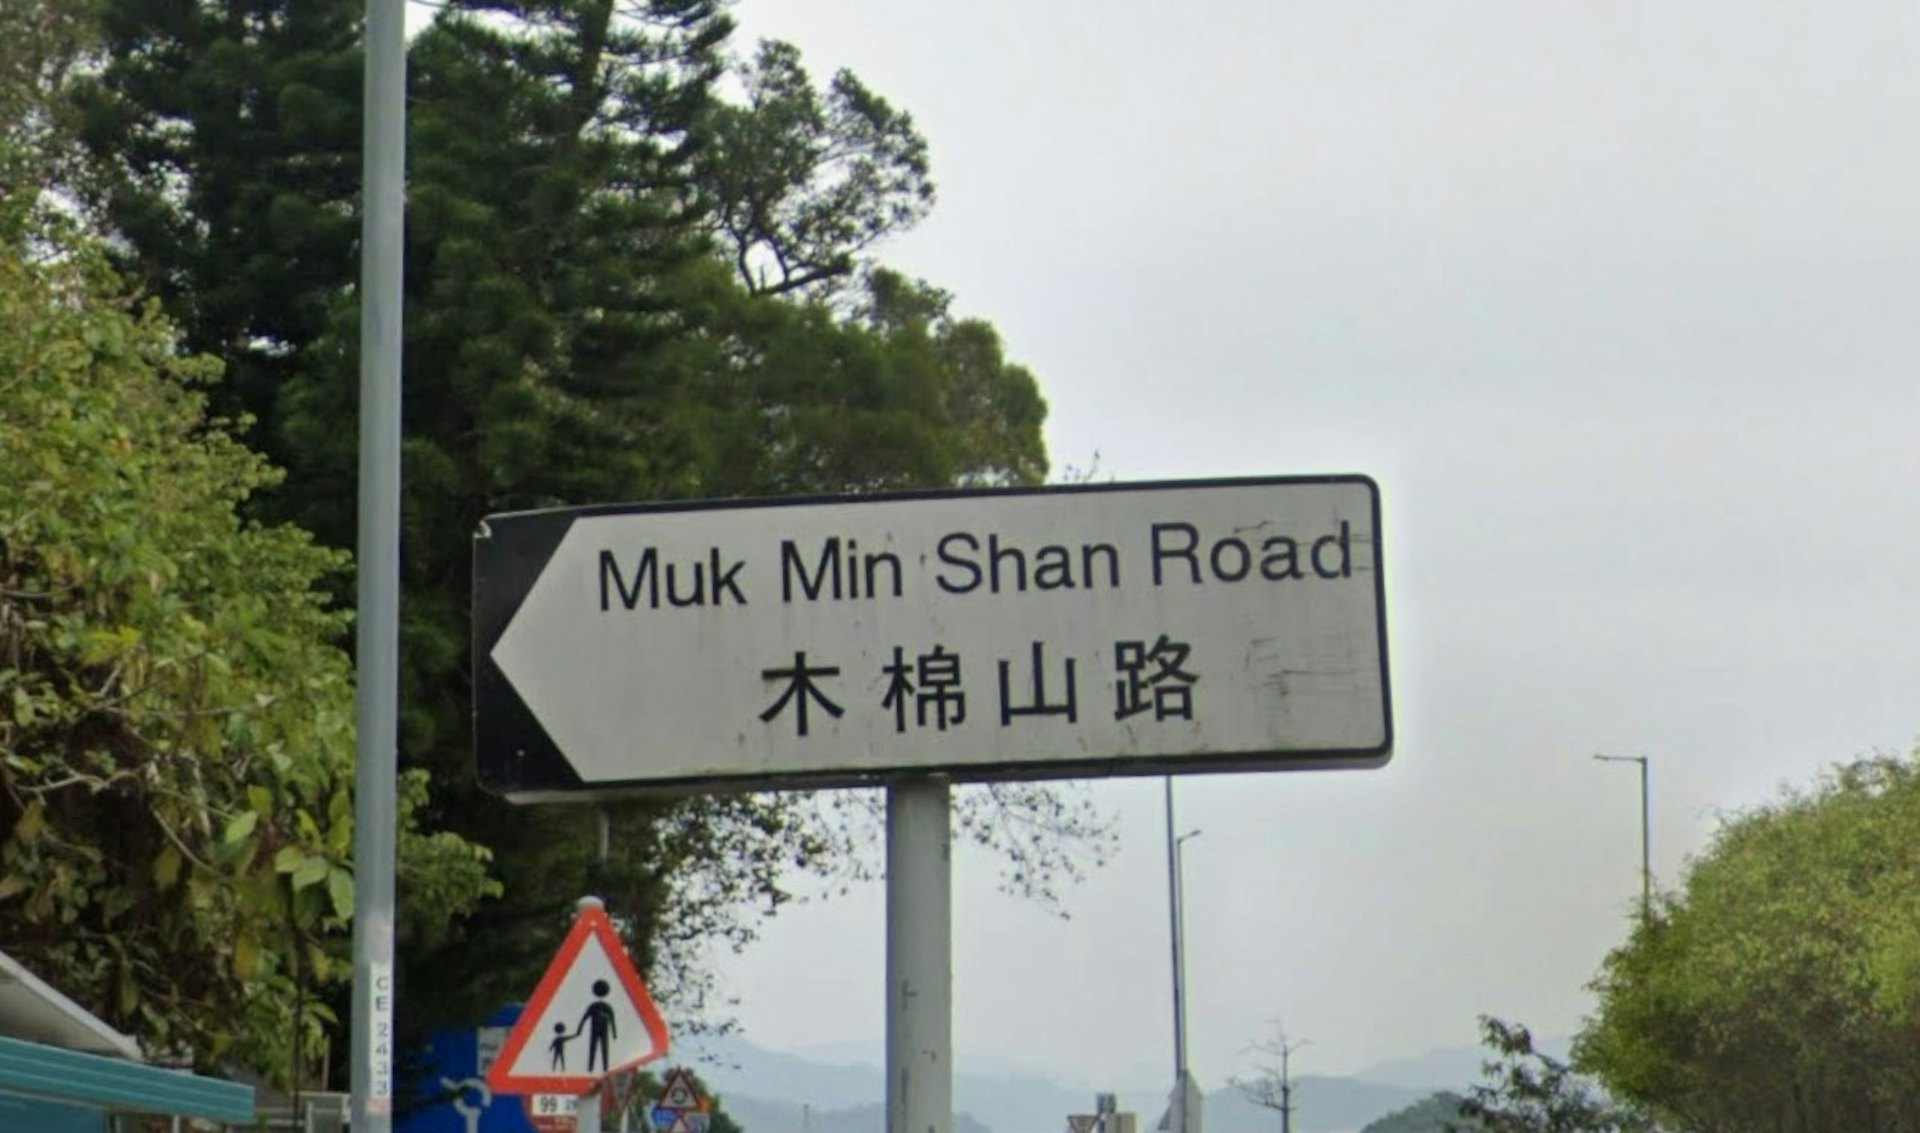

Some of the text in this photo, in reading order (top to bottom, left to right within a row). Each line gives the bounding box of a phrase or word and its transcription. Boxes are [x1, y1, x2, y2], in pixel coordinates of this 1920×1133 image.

[599, 519, 1352, 611] Muk Min Shan Road
[758, 634, 1199, 737] 木棉山路
